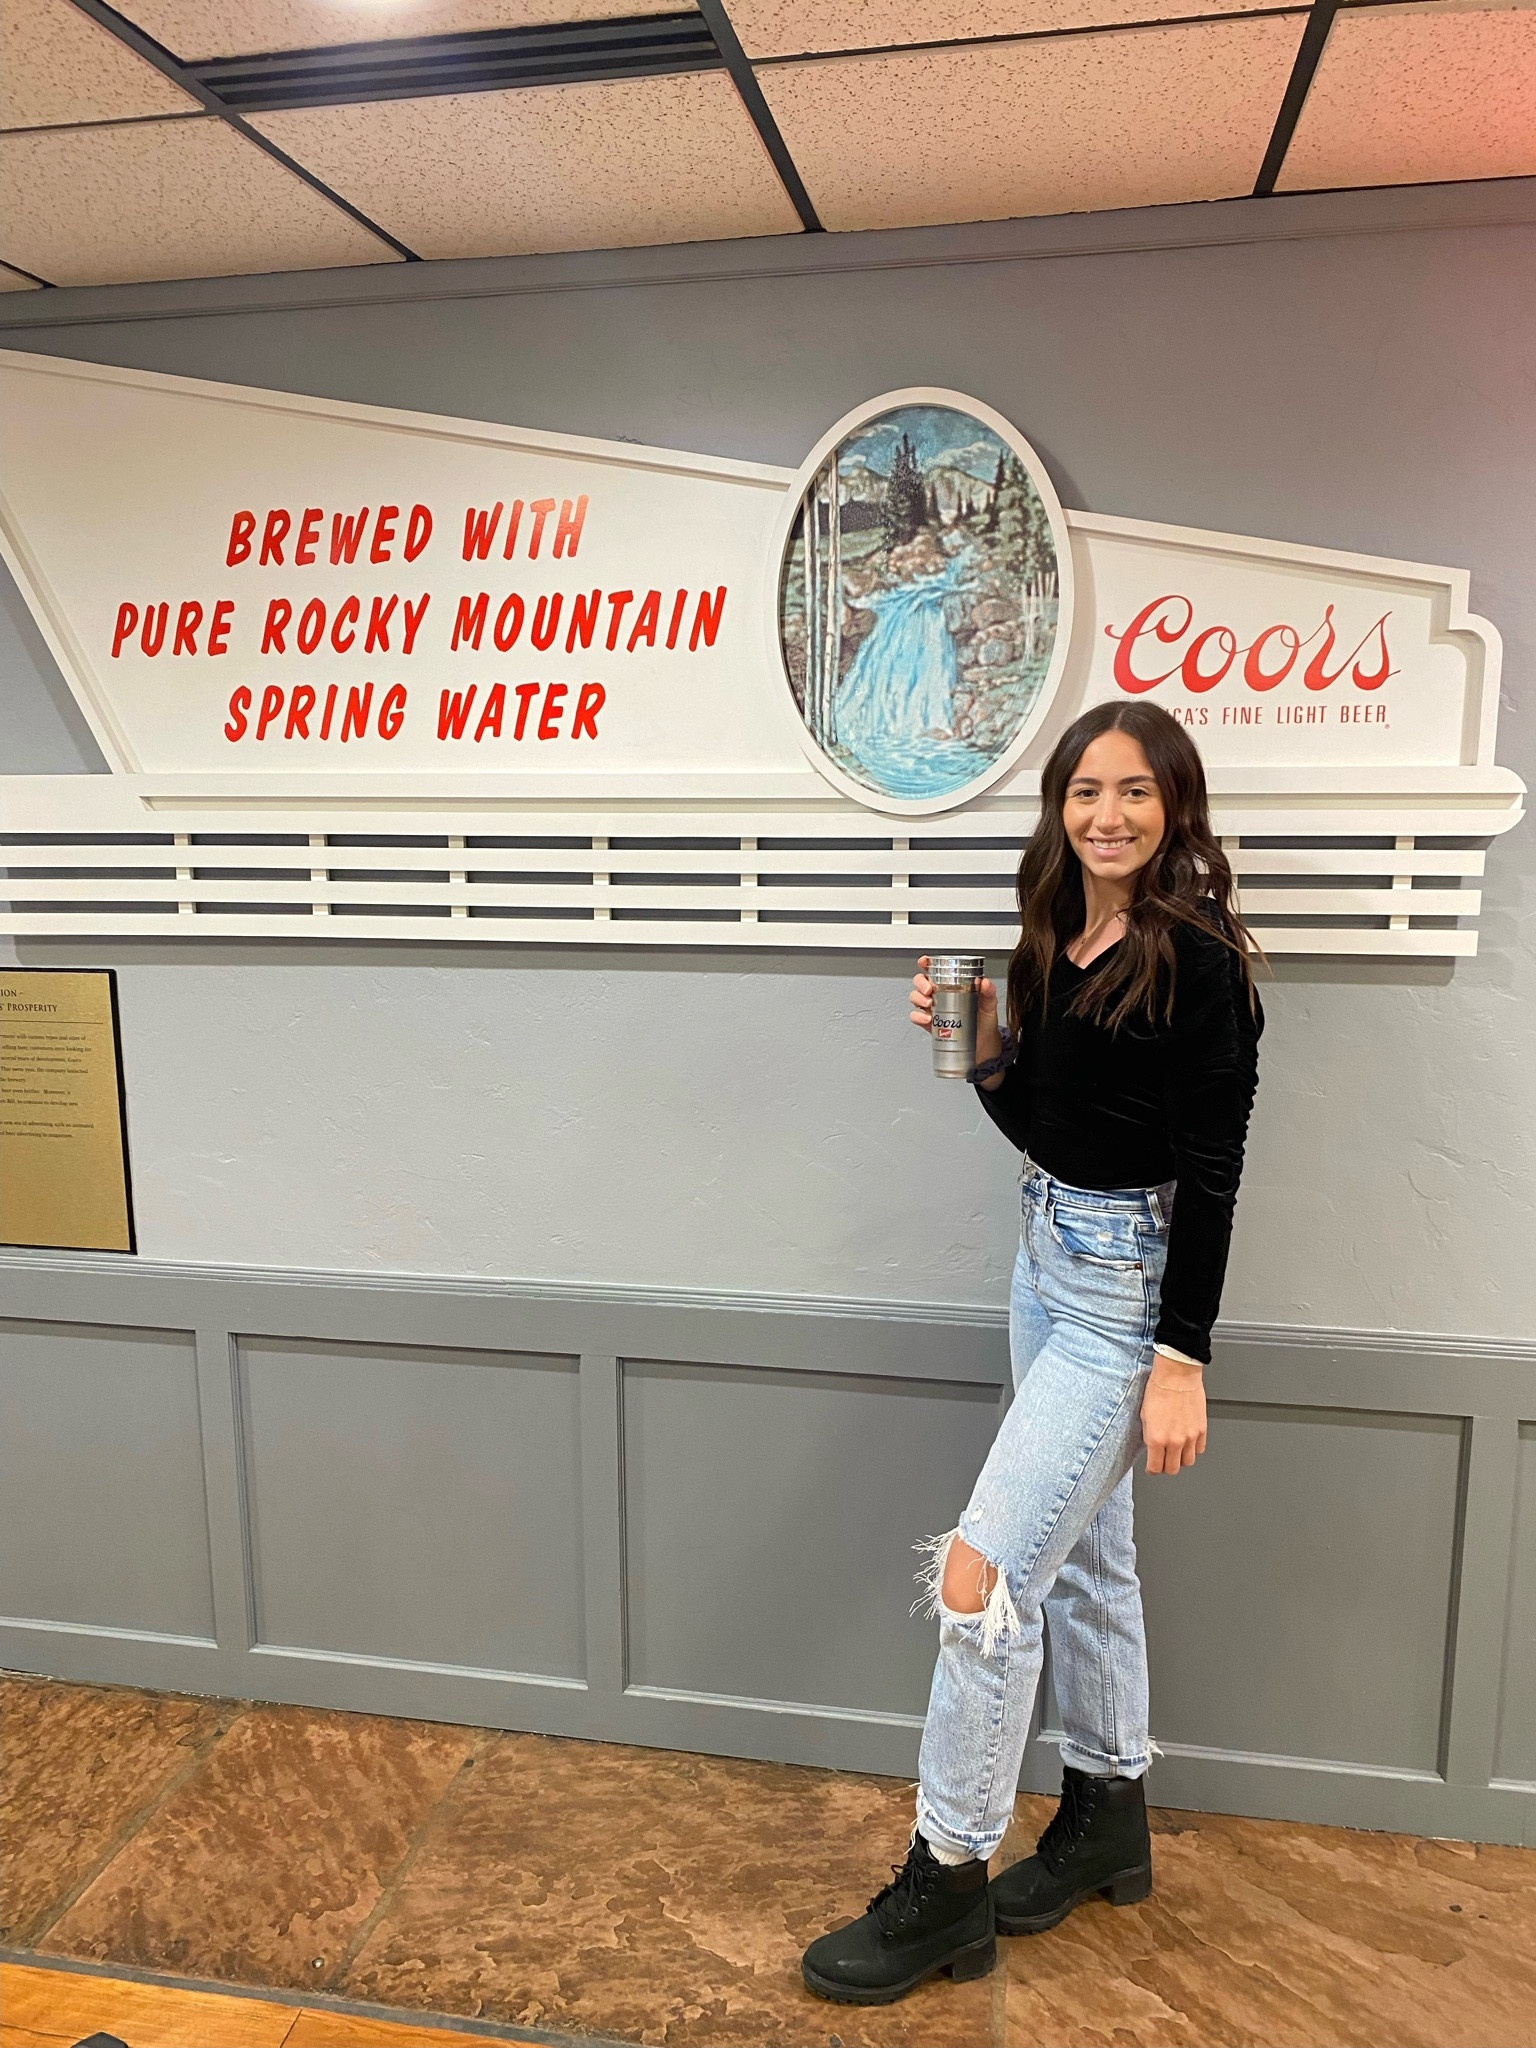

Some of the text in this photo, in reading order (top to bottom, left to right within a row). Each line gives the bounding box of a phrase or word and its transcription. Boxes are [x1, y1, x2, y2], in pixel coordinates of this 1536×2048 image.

[226, 495, 589, 567] BREWED WITH
[111, 585, 728, 658] PURE ROCKY MOUNTAIN
[1104, 594, 1401, 694] Coors
[224, 682, 606, 743] SPRING WATER
[1222, 706, 1264, 725] FINE
[1276, 705, 1328, 725] LIGHT
[1340, 704, 1387, 723] BEER
[7, 1002, 58, 1013] PROSPERITY
[932, 1014, 962, 1028] Coors
